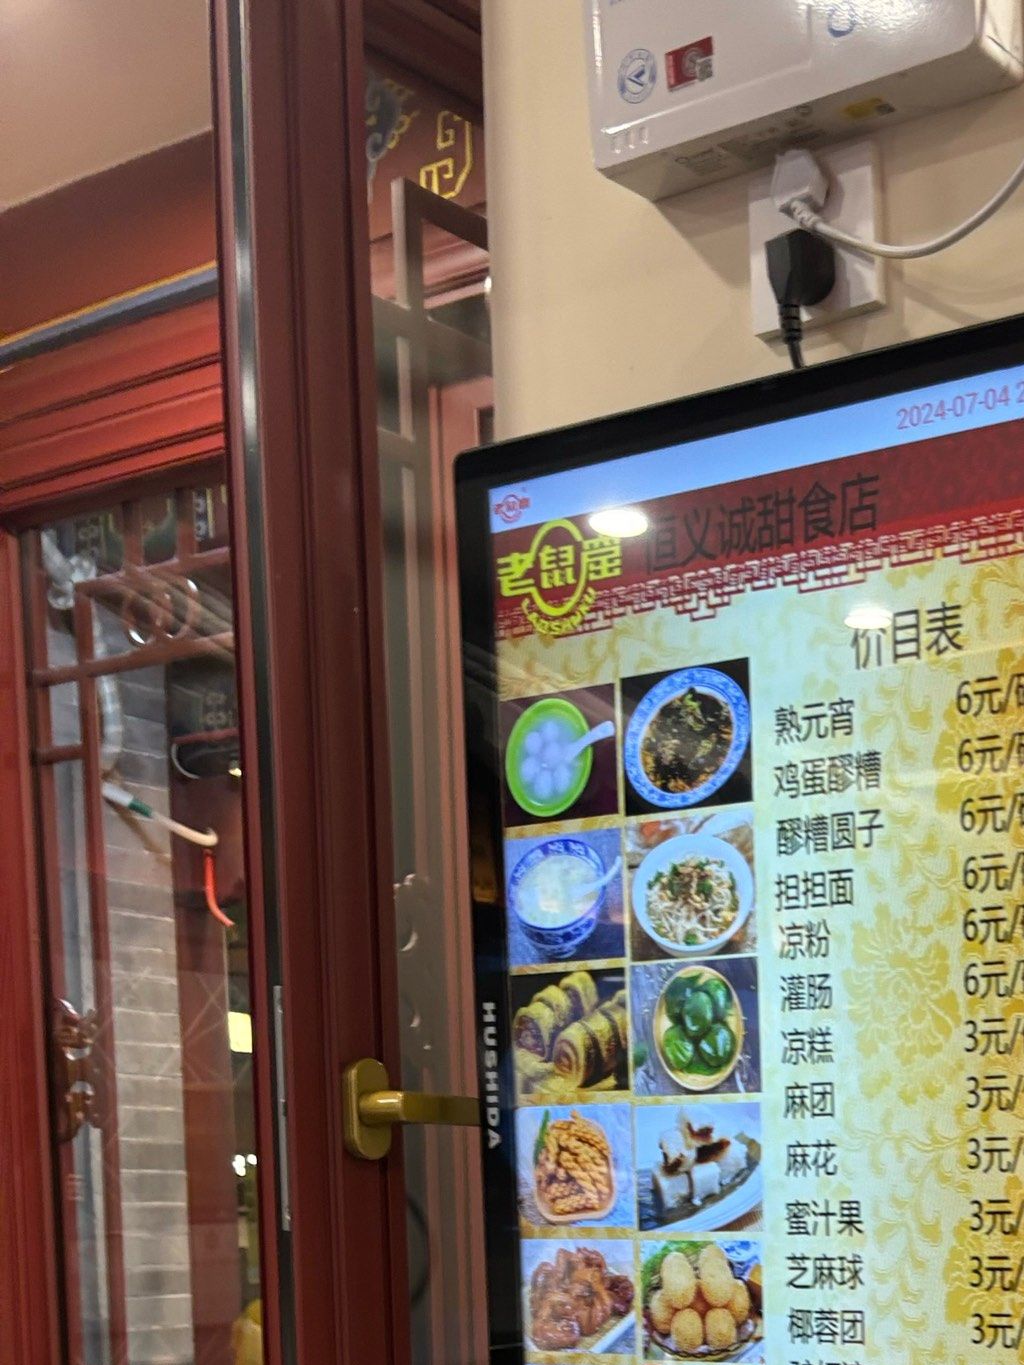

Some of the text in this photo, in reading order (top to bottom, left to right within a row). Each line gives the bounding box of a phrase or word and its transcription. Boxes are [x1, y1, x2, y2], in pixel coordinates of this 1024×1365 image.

[896, 385, 1009, 429] 2024-07-04
[850, 602, 963, 670] 价目表
[774, 698, 855, 745] 熟元宵
[773, 751, 882, 798] 鸡蛋醪糟
[776, 809, 884, 857] 醪糟圆子
[775, 869, 855, 912] 担担面
[778, 919, 830, 960] 凉粉
[781, 1028, 834, 1066] 凉糕
[482, 1001, 501, 1149] HUSHIDA
[783, 1082, 835, 1120] 麻团
[783, 1140, 838, 1177] 麻花
[785, 1199, 864, 1238] 蜜汁果
[786, 1254, 864, 1291] 芝麻球
[788, 1308, 866, 1347] 椰蓉团
